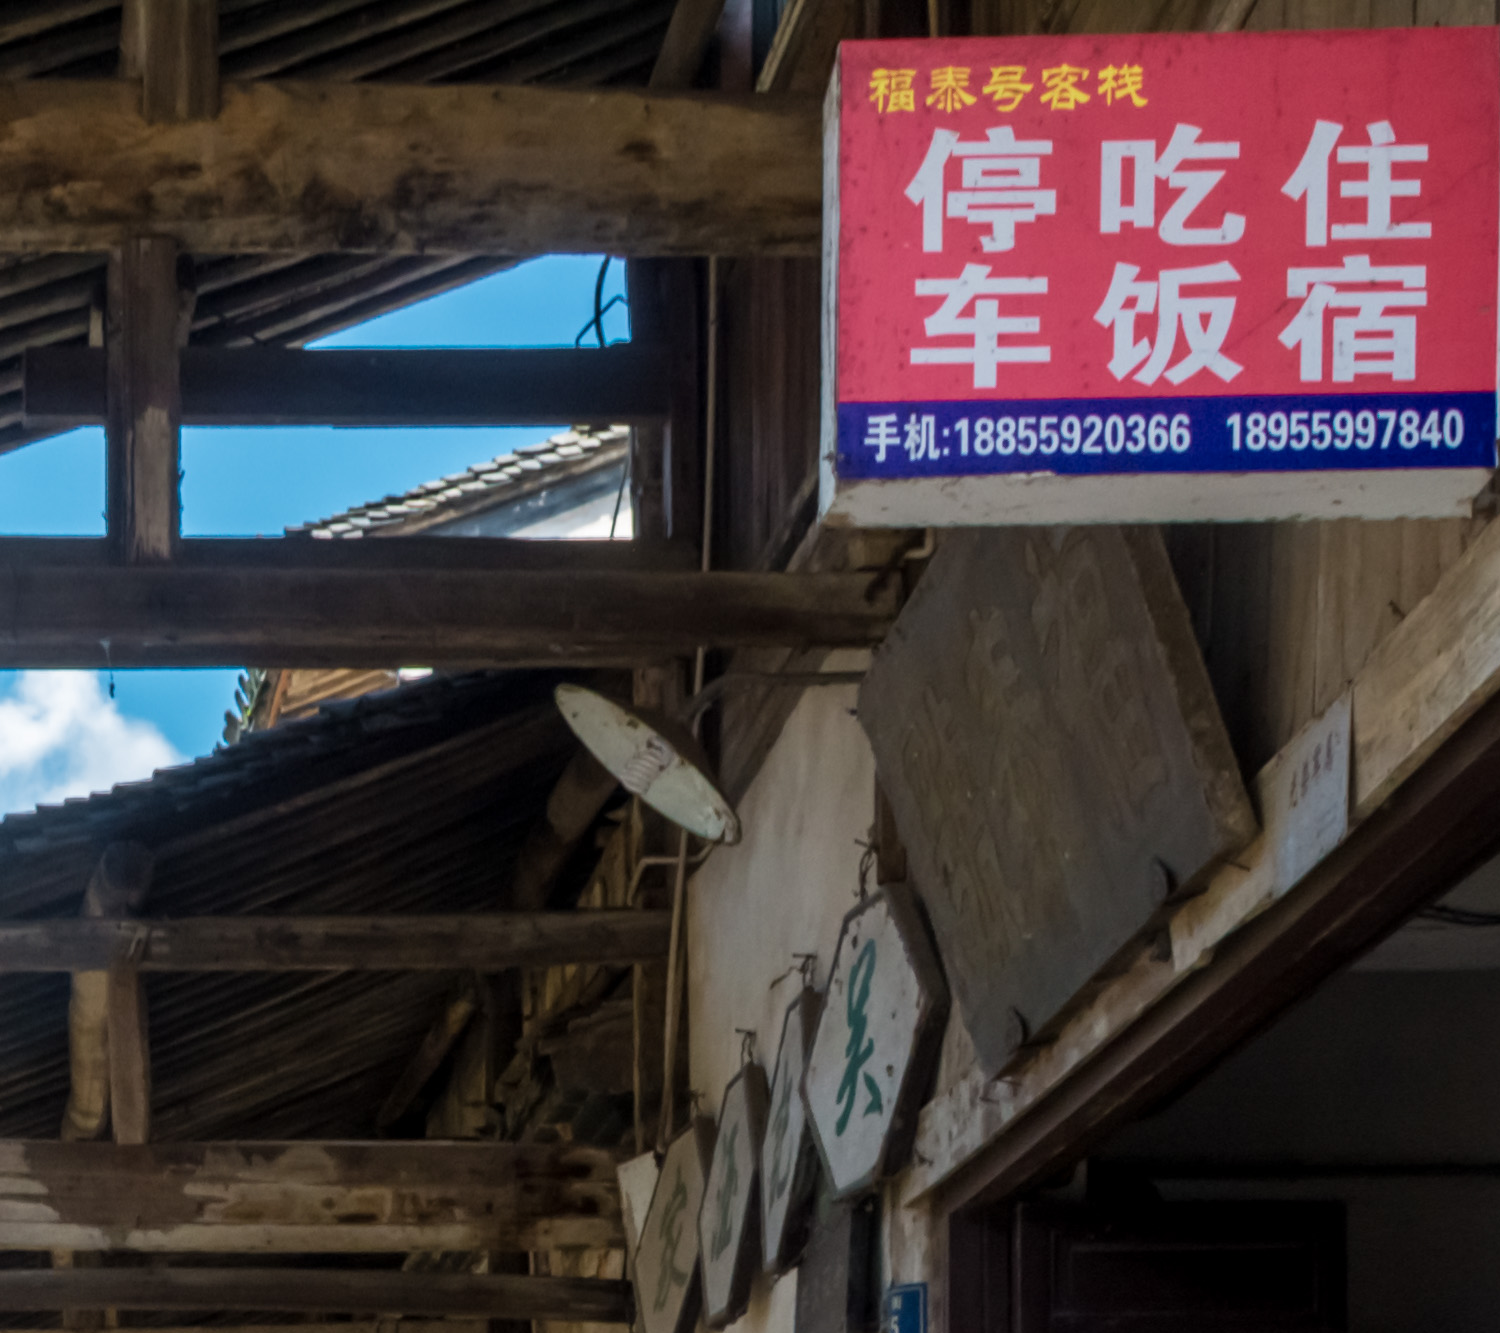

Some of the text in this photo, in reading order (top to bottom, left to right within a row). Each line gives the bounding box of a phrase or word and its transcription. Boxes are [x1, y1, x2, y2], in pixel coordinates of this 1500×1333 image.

[868, 62, 1150, 114] 福泰号客栈
[904, 125, 1059, 391] 停车
[1092, 121, 1249, 386] 吃饭
[1277, 118, 1434, 385] 住宿
[1224, 407, 1466, 455] 18955997840
